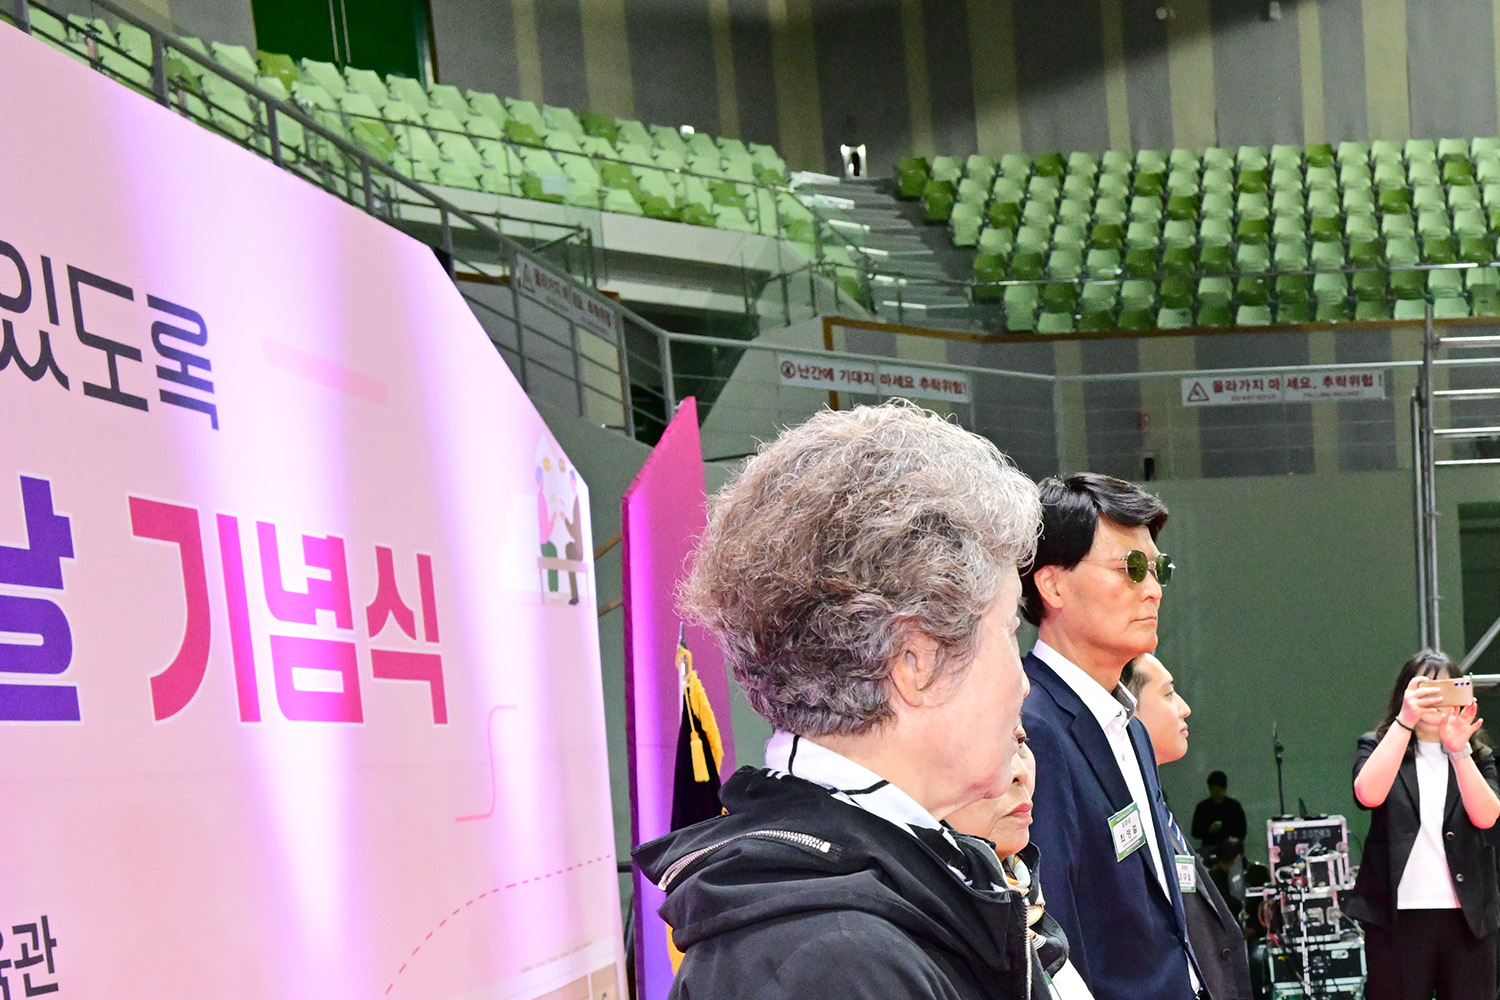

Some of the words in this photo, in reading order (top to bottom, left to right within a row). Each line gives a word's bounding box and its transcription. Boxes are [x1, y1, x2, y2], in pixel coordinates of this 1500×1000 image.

[798, 363, 835, 382] 난간에
[839, 369, 875, 384] 기대지
[879, 373, 915, 389] 마세요
[126, 493, 450, 726] 기념식
